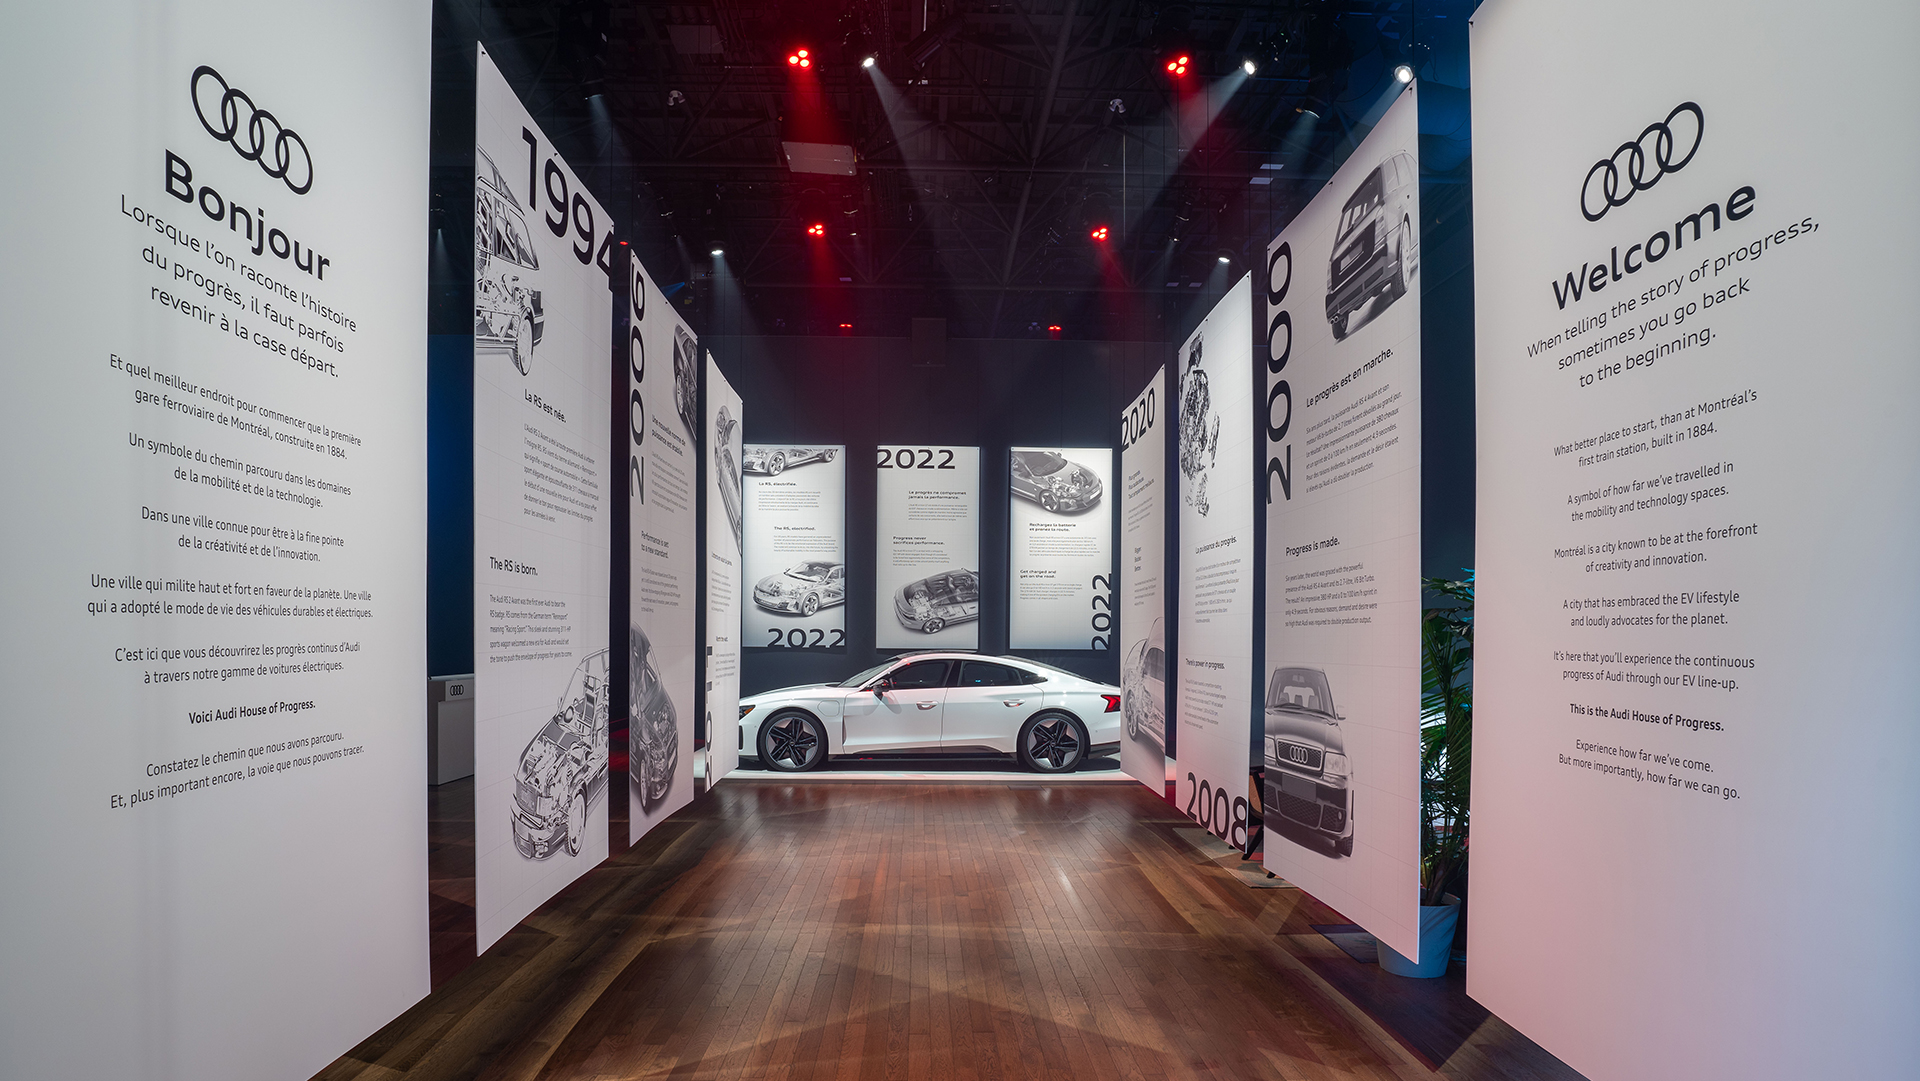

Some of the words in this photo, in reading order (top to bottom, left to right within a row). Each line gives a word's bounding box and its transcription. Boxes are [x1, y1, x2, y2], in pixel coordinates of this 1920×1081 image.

[165, 149, 330, 281] Bonjour
[522, 126, 612, 290] 1994
[122, 194, 200, 252] Lorsque
[241, 264, 297, 302] raconte
[1552, 186, 1756, 310] Welcome
[142, 246, 166, 270] du
[174, 262, 245, 310] progrès,
[252, 296, 260, 314] il
[264, 303, 294, 330] faut
[299, 323, 344, 352] parfois
[1527, 334, 1561, 357] When
[1565, 312, 1606, 340] telling
[1611, 299, 1636, 318] the
[1641, 275, 1684, 305] story
[1689, 259, 1709, 282] of
[1715, 218, 1819, 276] progress,
[152, 287, 215, 324] revenir
[220, 313, 229, 332] à
[235, 320, 248, 340] la
[254, 333, 286, 356] case
[291, 347, 338, 377] départ.
[1559, 328, 1635, 370] sometimes
[1639, 314, 1668, 340] you
[1674, 302, 1696, 325] go
[1704, 278, 1750, 309] back
[1580, 374, 1594, 387] to
[1597, 363, 1621, 380] the
[1626, 328, 1716, 370] beginning.
[110, 354, 122, 370] Et
[126, 363, 151, 379] quel
[154, 372, 198, 394] meilleur
[200, 388, 234, 406] endroit
[237, 400, 257, 413] pour
[259, 408, 306, 428] commencer
[307, 423, 321, 434] que
[323, 425, 329, 436] la
[331, 431, 361, 446] première
[525, 389, 532, 402] La
[534, 394, 542, 408] RS
[543, 402, 553, 415] est
[631, 262, 645, 505] 2006
[1267, 241, 1292, 504] 2000
[1306, 398, 1314, 408] Le
[1314, 382, 1339, 404] progrès
[1340, 373, 1352, 387] est
[1352, 367, 1362, 380] en
[1363, 347, 1394, 373] marche.
[1122, 388, 1155, 452] 2020
[1554, 444, 1572, 456] What
[1575, 437, 1597, 450] better
[1599, 431, 1620, 446] place
[1622, 428, 1631, 437] to
[1633, 419, 1657, 434] start,
[1660, 413, 1682, 426] than
[1685, 407, 1695, 419] at
[877, 449, 955, 470] 2022
[490, 557, 502, 570] The
[504, 559, 513, 572] RS
[514, 561, 520, 573] is
[521, 563, 538, 576] born.
[1285, 543, 1312, 556] Progress
[1313, 541, 1318, 551] is
[1319, 536, 1340, 549] made.
[767, 628, 845, 648] 2022
[1092, 573, 1112, 649] 2022
[147, 648, 158, 660] ici
[161, 650, 180, 662] que
[183, 649, 206, 658] vous
[209, 645, 260, 657] découvrirez
[262, 644, 274, 655] les
[276, 644, 306, 657] progrès
[307, 643, 338, 653] continus
[189, 710, 212, 724] Voici
[215, 707, 237, 721] Audi
[240, 706, 266, 718] House
[269, 702, 278, 714] of
[280, 701, 315, 714] Progress.
[1570, 704, 1585, 714] This
[1587, 706, 1593, 716] is
[1595, 706, 1608, 717] the
[1610, 708, 1630, 720] Audi
[1632, 710, 1660, 724] House
[1662, 714, 1673, 725] of
[1676, 715, 1724, 731] Progress.
[1576, 739, 1617, 756] Experience
[1619, 746, 1637, 758] how
[1639, 749, 1652, 761] far
[1683, 760, 1713, 772] come.
[1187, 772, 1247, 853] 2008
